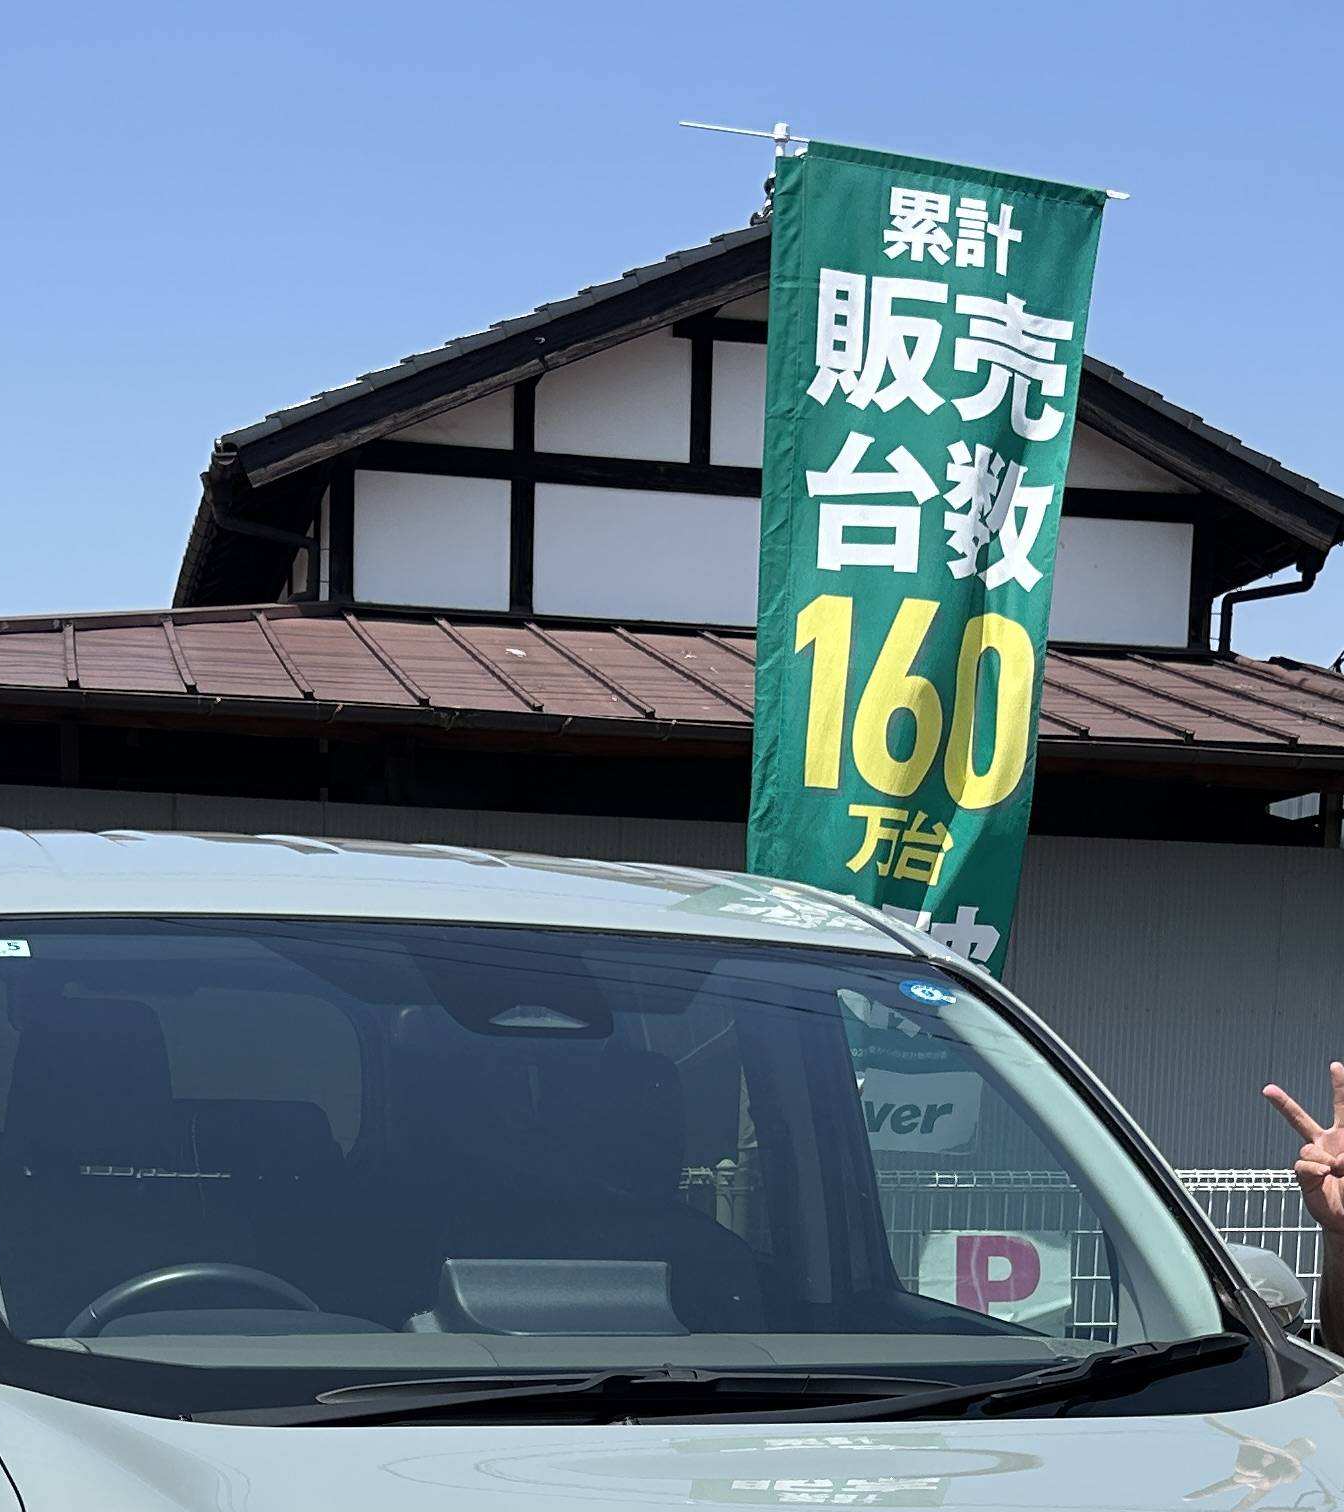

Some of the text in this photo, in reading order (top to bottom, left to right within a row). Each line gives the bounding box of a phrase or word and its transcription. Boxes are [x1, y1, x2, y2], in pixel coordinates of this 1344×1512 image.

[883, 186, 1023, 276] 累計
[806, 268, 1075, 442] 販売
[805, 431, 1055, 592] 台数
[794, 594, 1035, 810] 160
[846, 804, 954, 886] 万台
[863, 1100, 954, 1135] ver
[956, 1235, 1040, 1316] P
